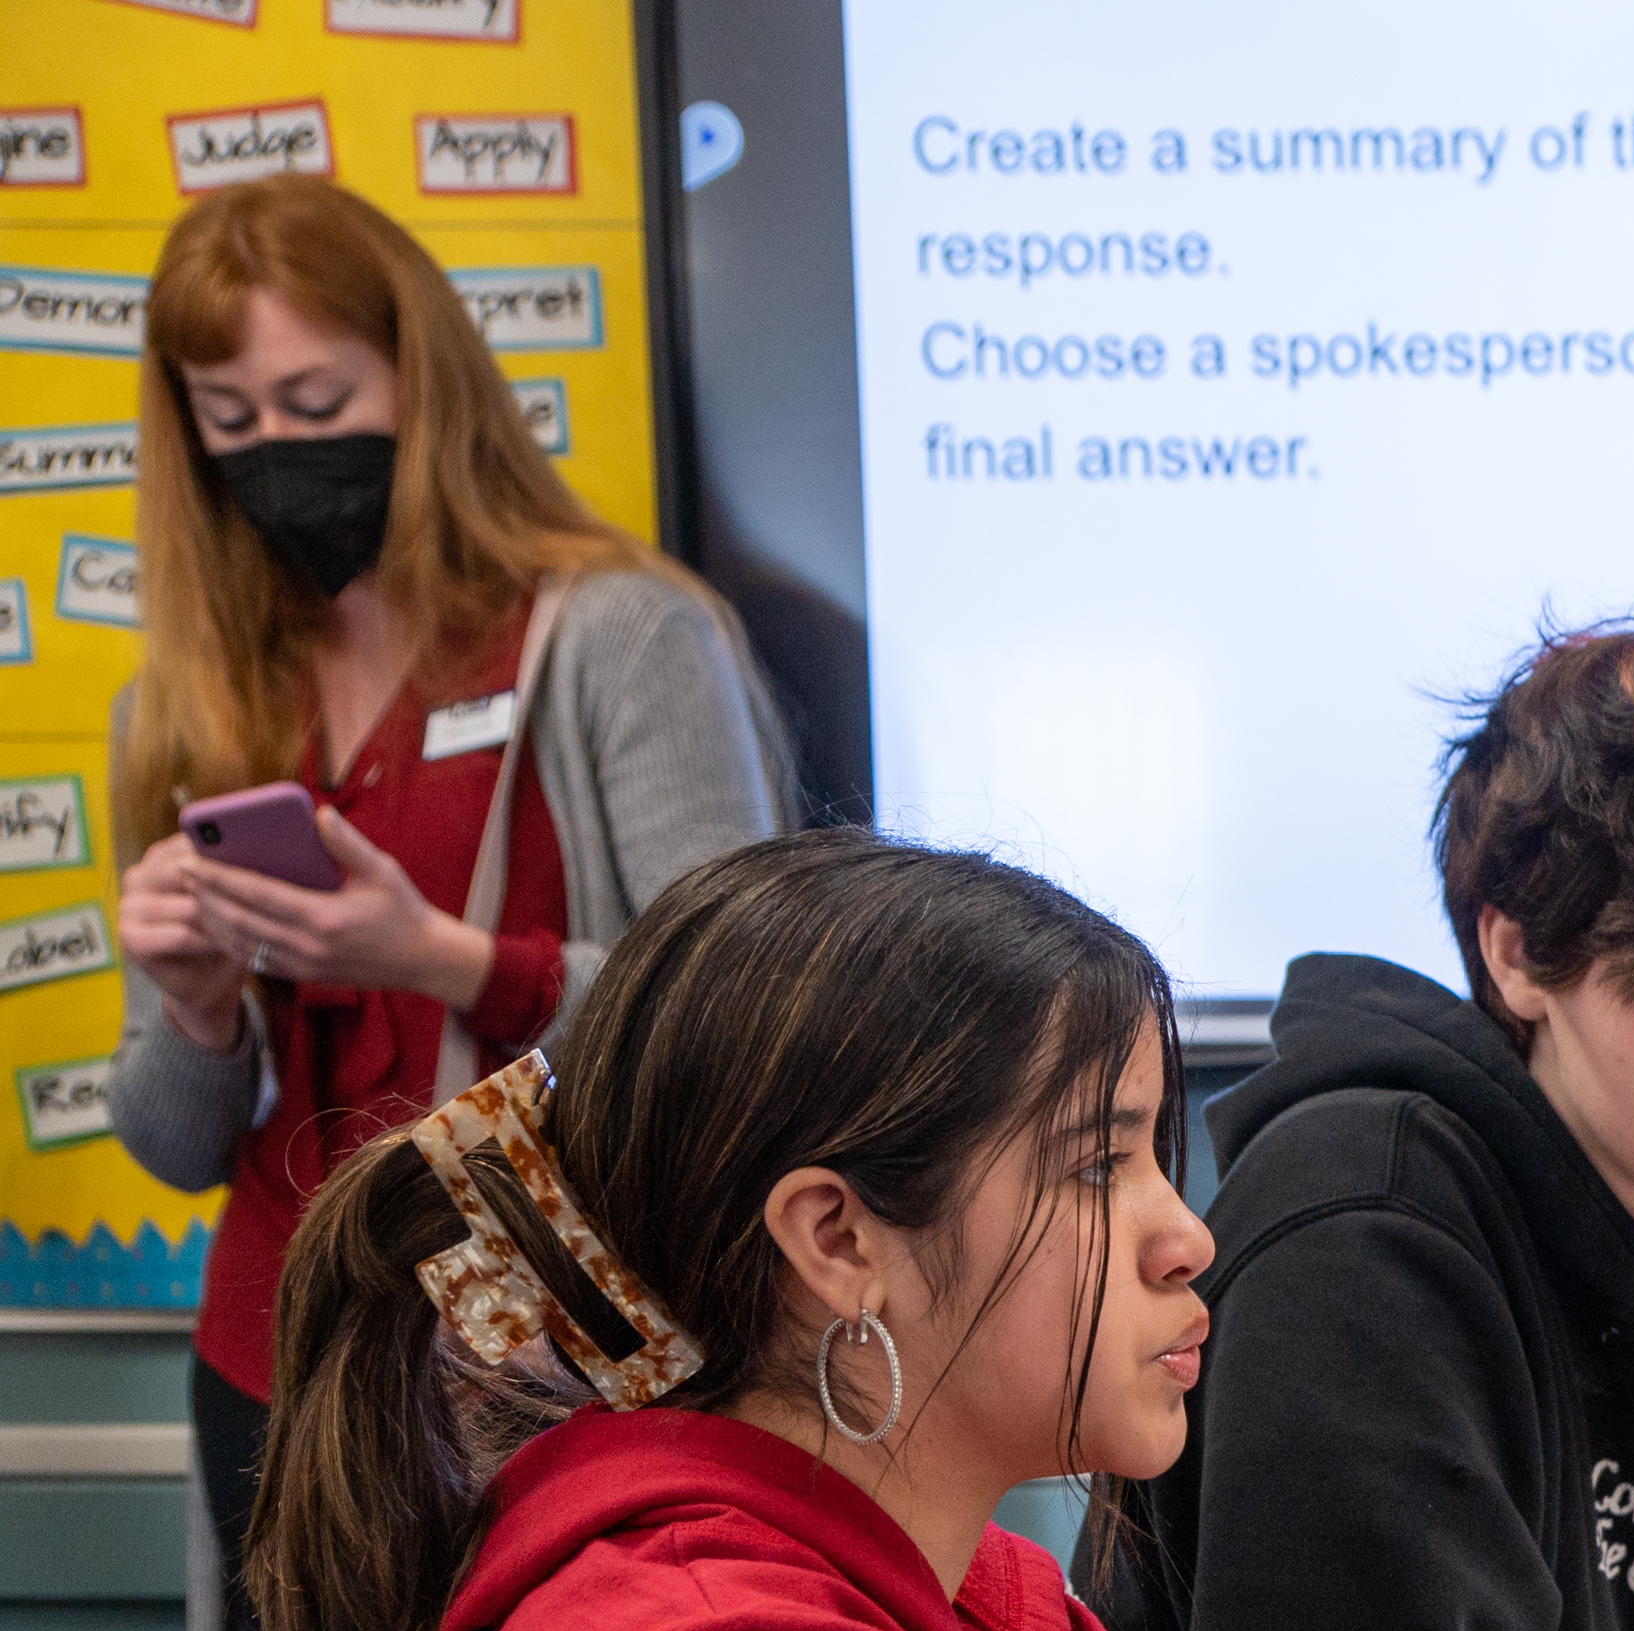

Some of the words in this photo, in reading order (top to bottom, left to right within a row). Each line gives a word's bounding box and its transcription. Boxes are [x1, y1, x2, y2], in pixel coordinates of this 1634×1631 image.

[181, 113, 317, 170] Judge
[430, 119, 555, 185] Apply
[911, 114, 1129, 177] Create
[1149, 127, 1189, 176] a
[1210, 126, 1508, 188] summary
[1528, 110, 1590, 172] of
[916, 231, 1230, 290] response.
[919, 320, 1168, 382] Choose
[1189, 333, 1228, 380] a
[922, 422, 1054, 483] final
[1076, 435, 1320, 483] answer.
